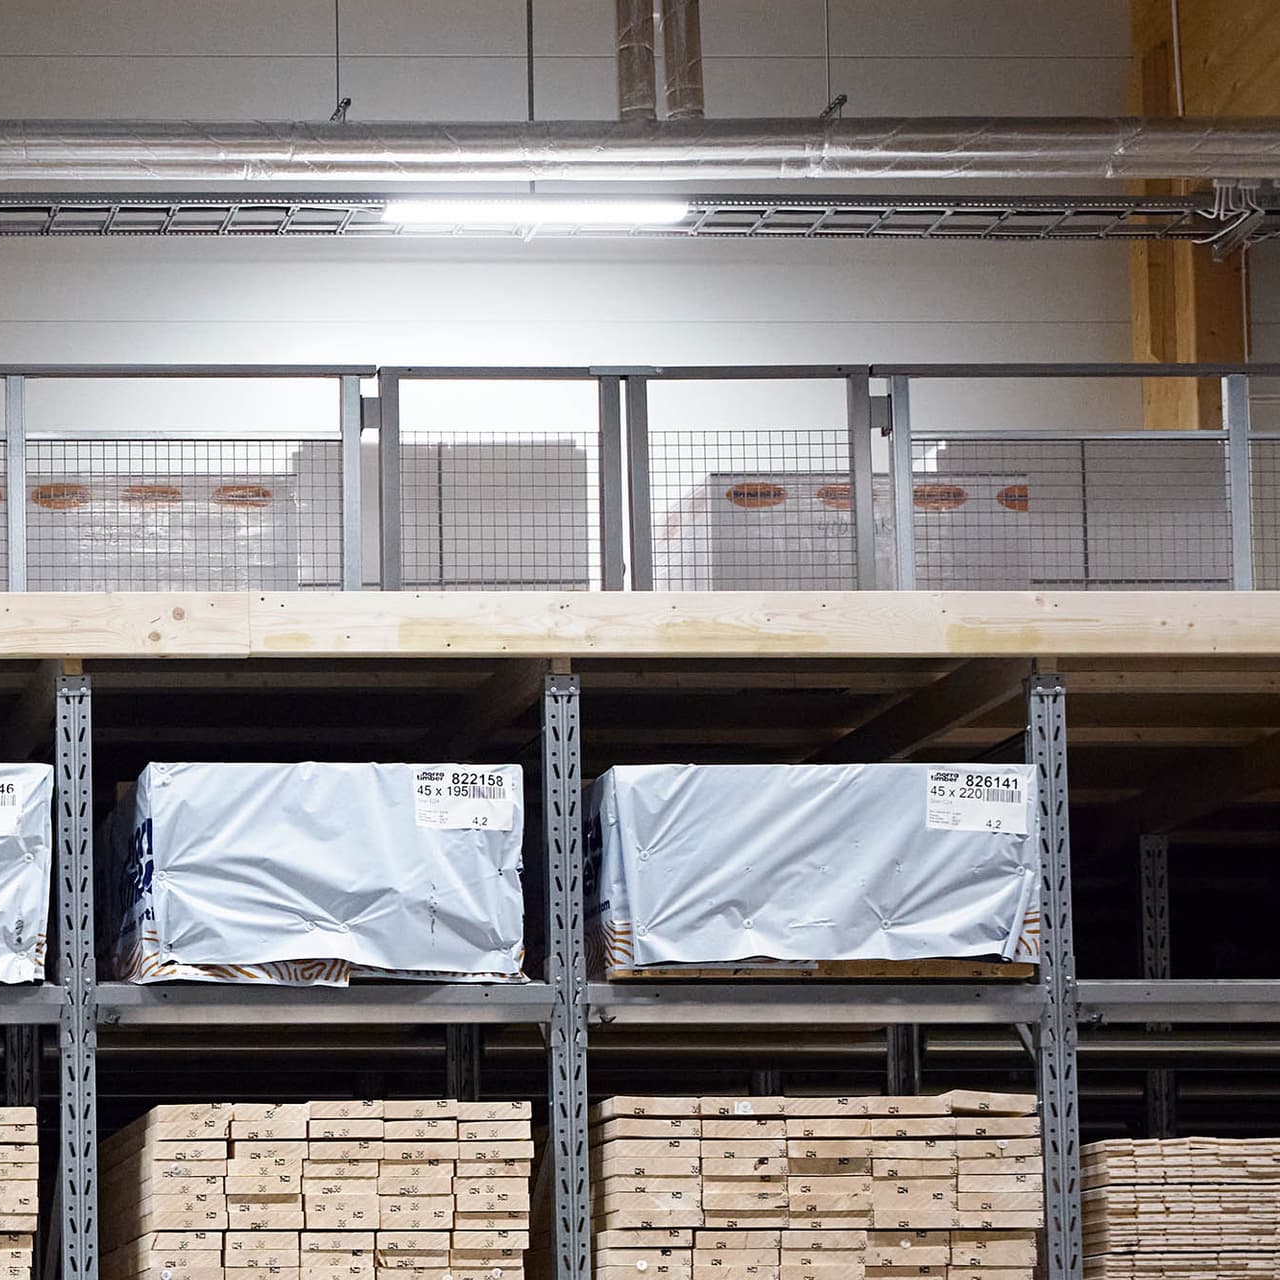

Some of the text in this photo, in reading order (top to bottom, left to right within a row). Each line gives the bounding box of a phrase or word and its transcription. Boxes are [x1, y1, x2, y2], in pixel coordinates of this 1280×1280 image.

[452, 773, 503, 786] 822158
[966, 776, 1019, 789] 826141
[417, 785, 431, 796] 45
[447, 786, 468, 796] 195
[930, 788, 945, 797] 45
[960, 788, 983, 799] 220
